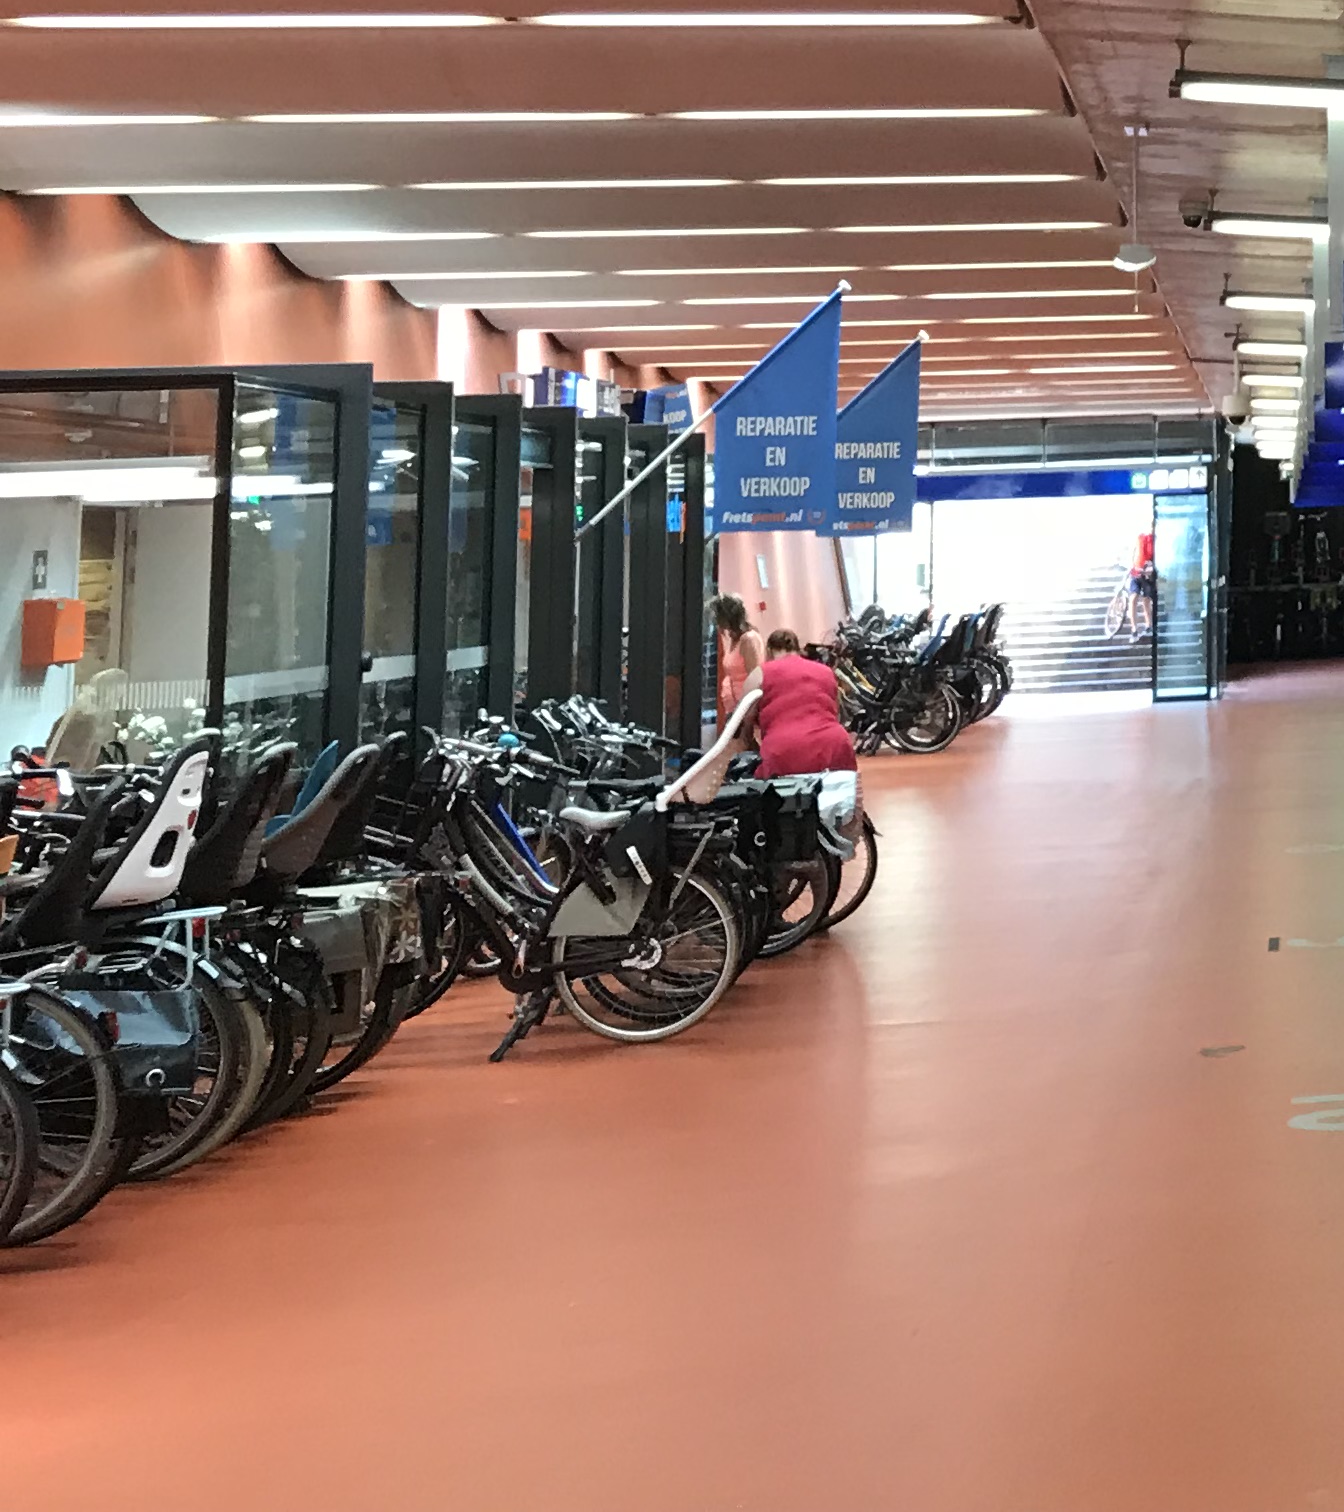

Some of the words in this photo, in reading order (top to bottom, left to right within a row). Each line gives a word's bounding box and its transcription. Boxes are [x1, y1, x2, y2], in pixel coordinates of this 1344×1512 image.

[736, 415, 818, 437] REPARATIE
[765, 446, 786, 467] EN
[834, 442, 901, 460] REPARATIE
[858, 467, 875, 485] EN
[740, 476, 811, 498] VERKOOP
[838, 491, 895, 510] VERKOOP
